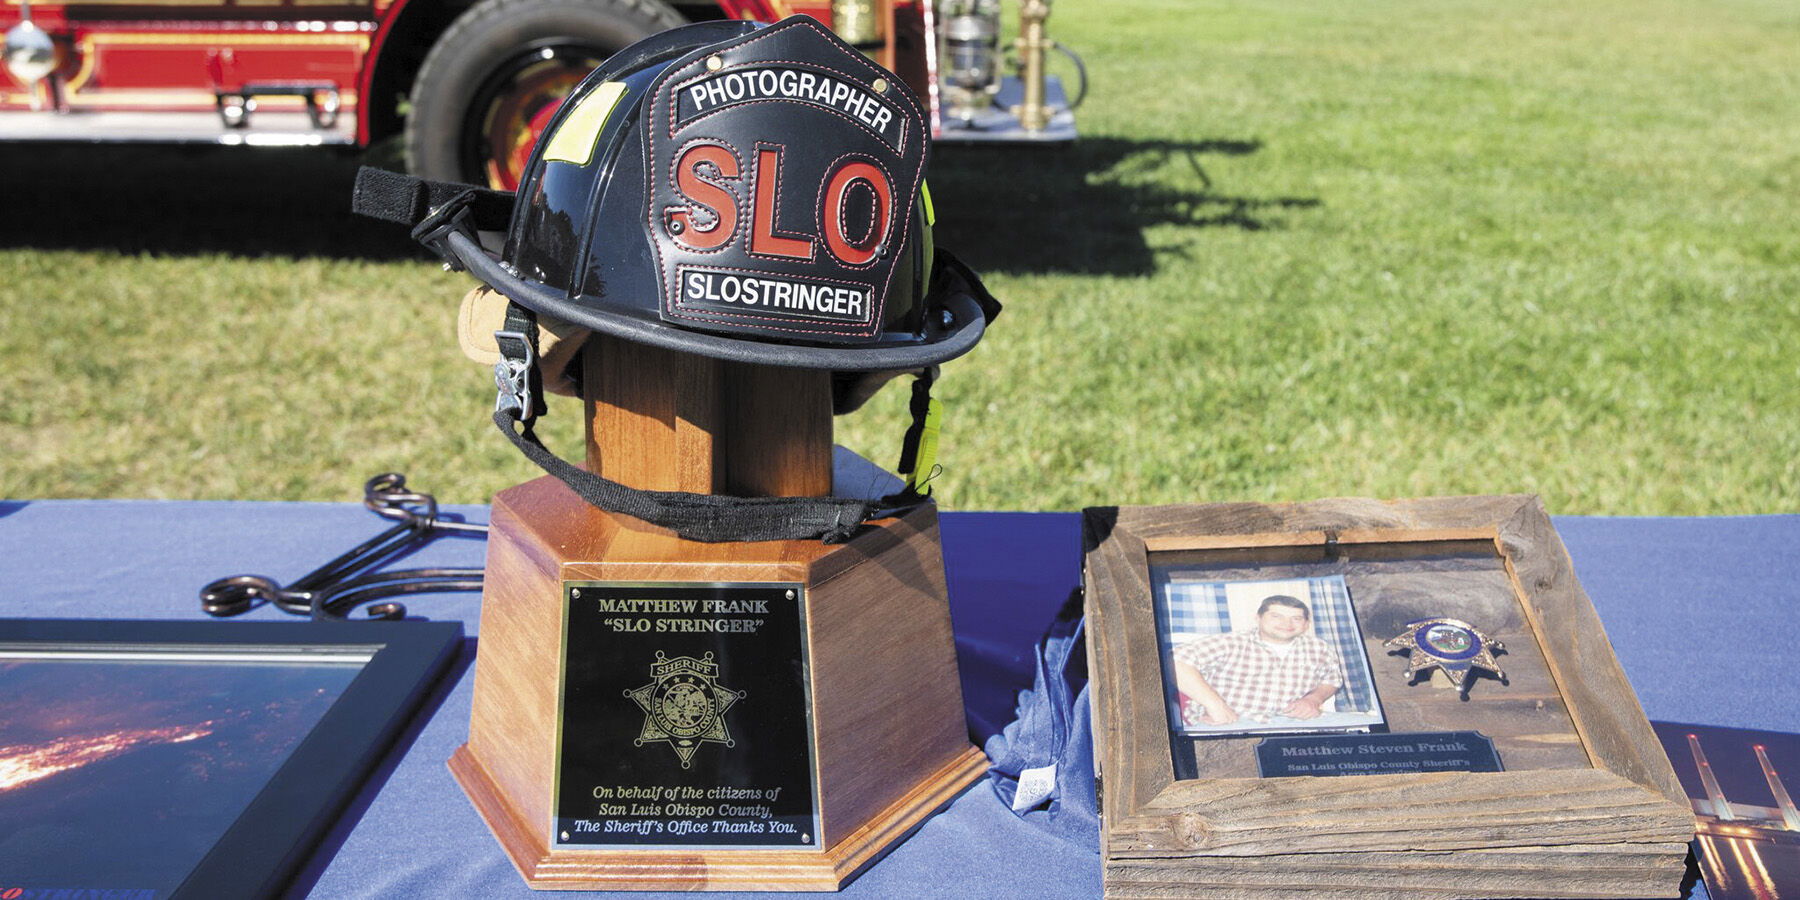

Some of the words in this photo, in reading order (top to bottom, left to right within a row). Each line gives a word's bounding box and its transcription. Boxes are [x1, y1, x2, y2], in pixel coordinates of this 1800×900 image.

[690, 69, 893, 134] PHOTOGRAPHER
[670, 145, 892, 264] SLO
[687, 272, 863, 316] SLOSTRINGER
[599, 599, 698, 614] MATTHEW
[702, 600, 769, 614] FRANK
[656, 660, 712, 675] SHERIFF
[1282, 747, 1352, 757] Matthew
[1357, 745, 1412, 755] Steven
[1416, 742, 1468, 752] Frank
[1338, 762, 1378, 771] Obispo
[1380, 760, 1420, 769] County
[593, 786, 614, 799] On
[617, 785, 664, 801] behalf
[664, 786, 681, 802] of
[681, 786, 704, 799] the
[706, 786, 762, 800] citizens
[765, 787, 782, 802] of
[599, 804, 627, 816] San
[631, 804, 661, 816] Luis
[665, 804, 715, 819] Obispo
[718, 804, 773, 819] County,
[574, 820, 601, 832] The
[668, 820, 708, 835] Office
[712, 821, 764, 834] Thanks
[767, 821, 798, 834] You.
